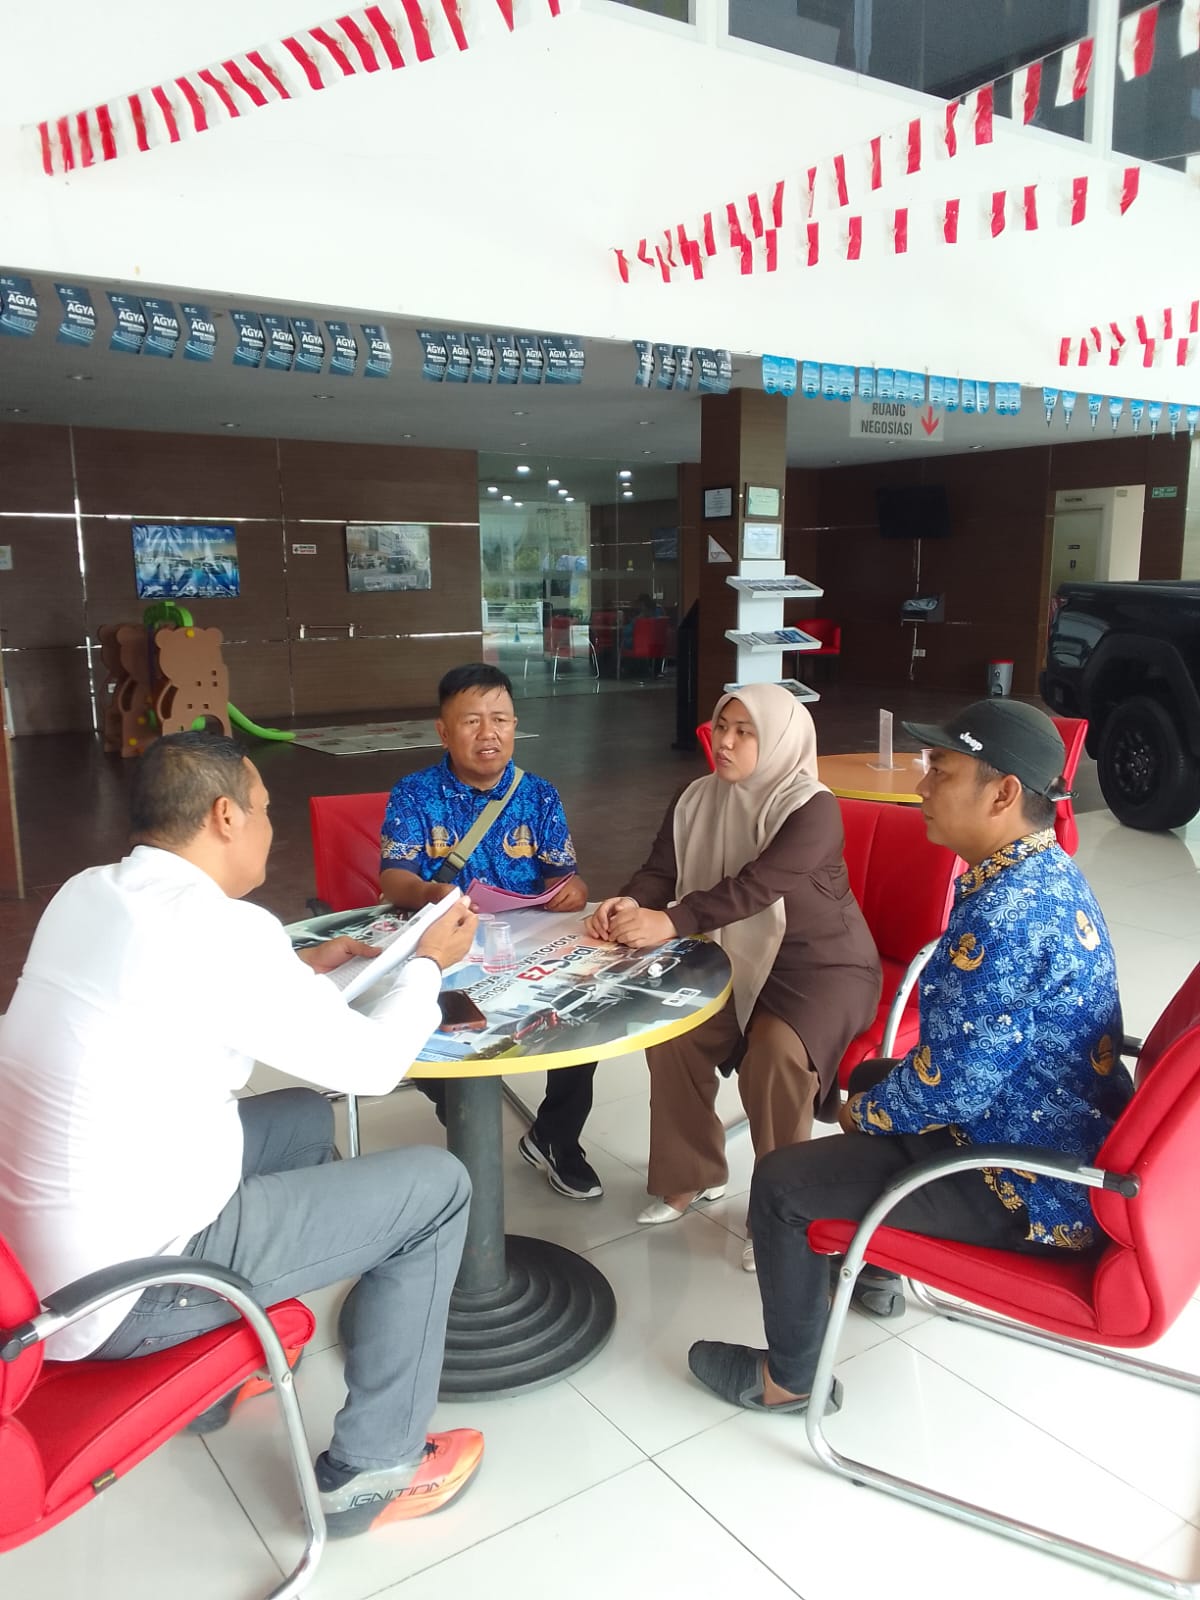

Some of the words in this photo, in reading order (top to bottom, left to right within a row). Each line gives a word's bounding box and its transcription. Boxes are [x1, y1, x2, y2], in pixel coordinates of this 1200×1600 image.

[8, 294, 37, 307] AGYA
[67, 303, 95, 316] AGYA
[118, 311, 145, 324] AGYA
[153, 316, 178, 328] AGYA
[191, 321, 215, 333] AGYA
[241, 328, 263, 339] AGYA
[272, 331, 293, 342] AGYA
[302, 334, 323, 345] AGYA
[336, 338, 356, 348] AGYA
[371, 341, 391, 351] AGYA
[426, 345, 446, 355] AGYA
[452, 346, 470, 356] AGYA
[503, 349, 519, 358] AGYA
[872, 402, 906, 417] RUANG
[861, 420, 912, 436] NEGOSIASI
[534, 934, 578, 959] TOYOTA
[350, 1482, 440, 1508] IGNITION
